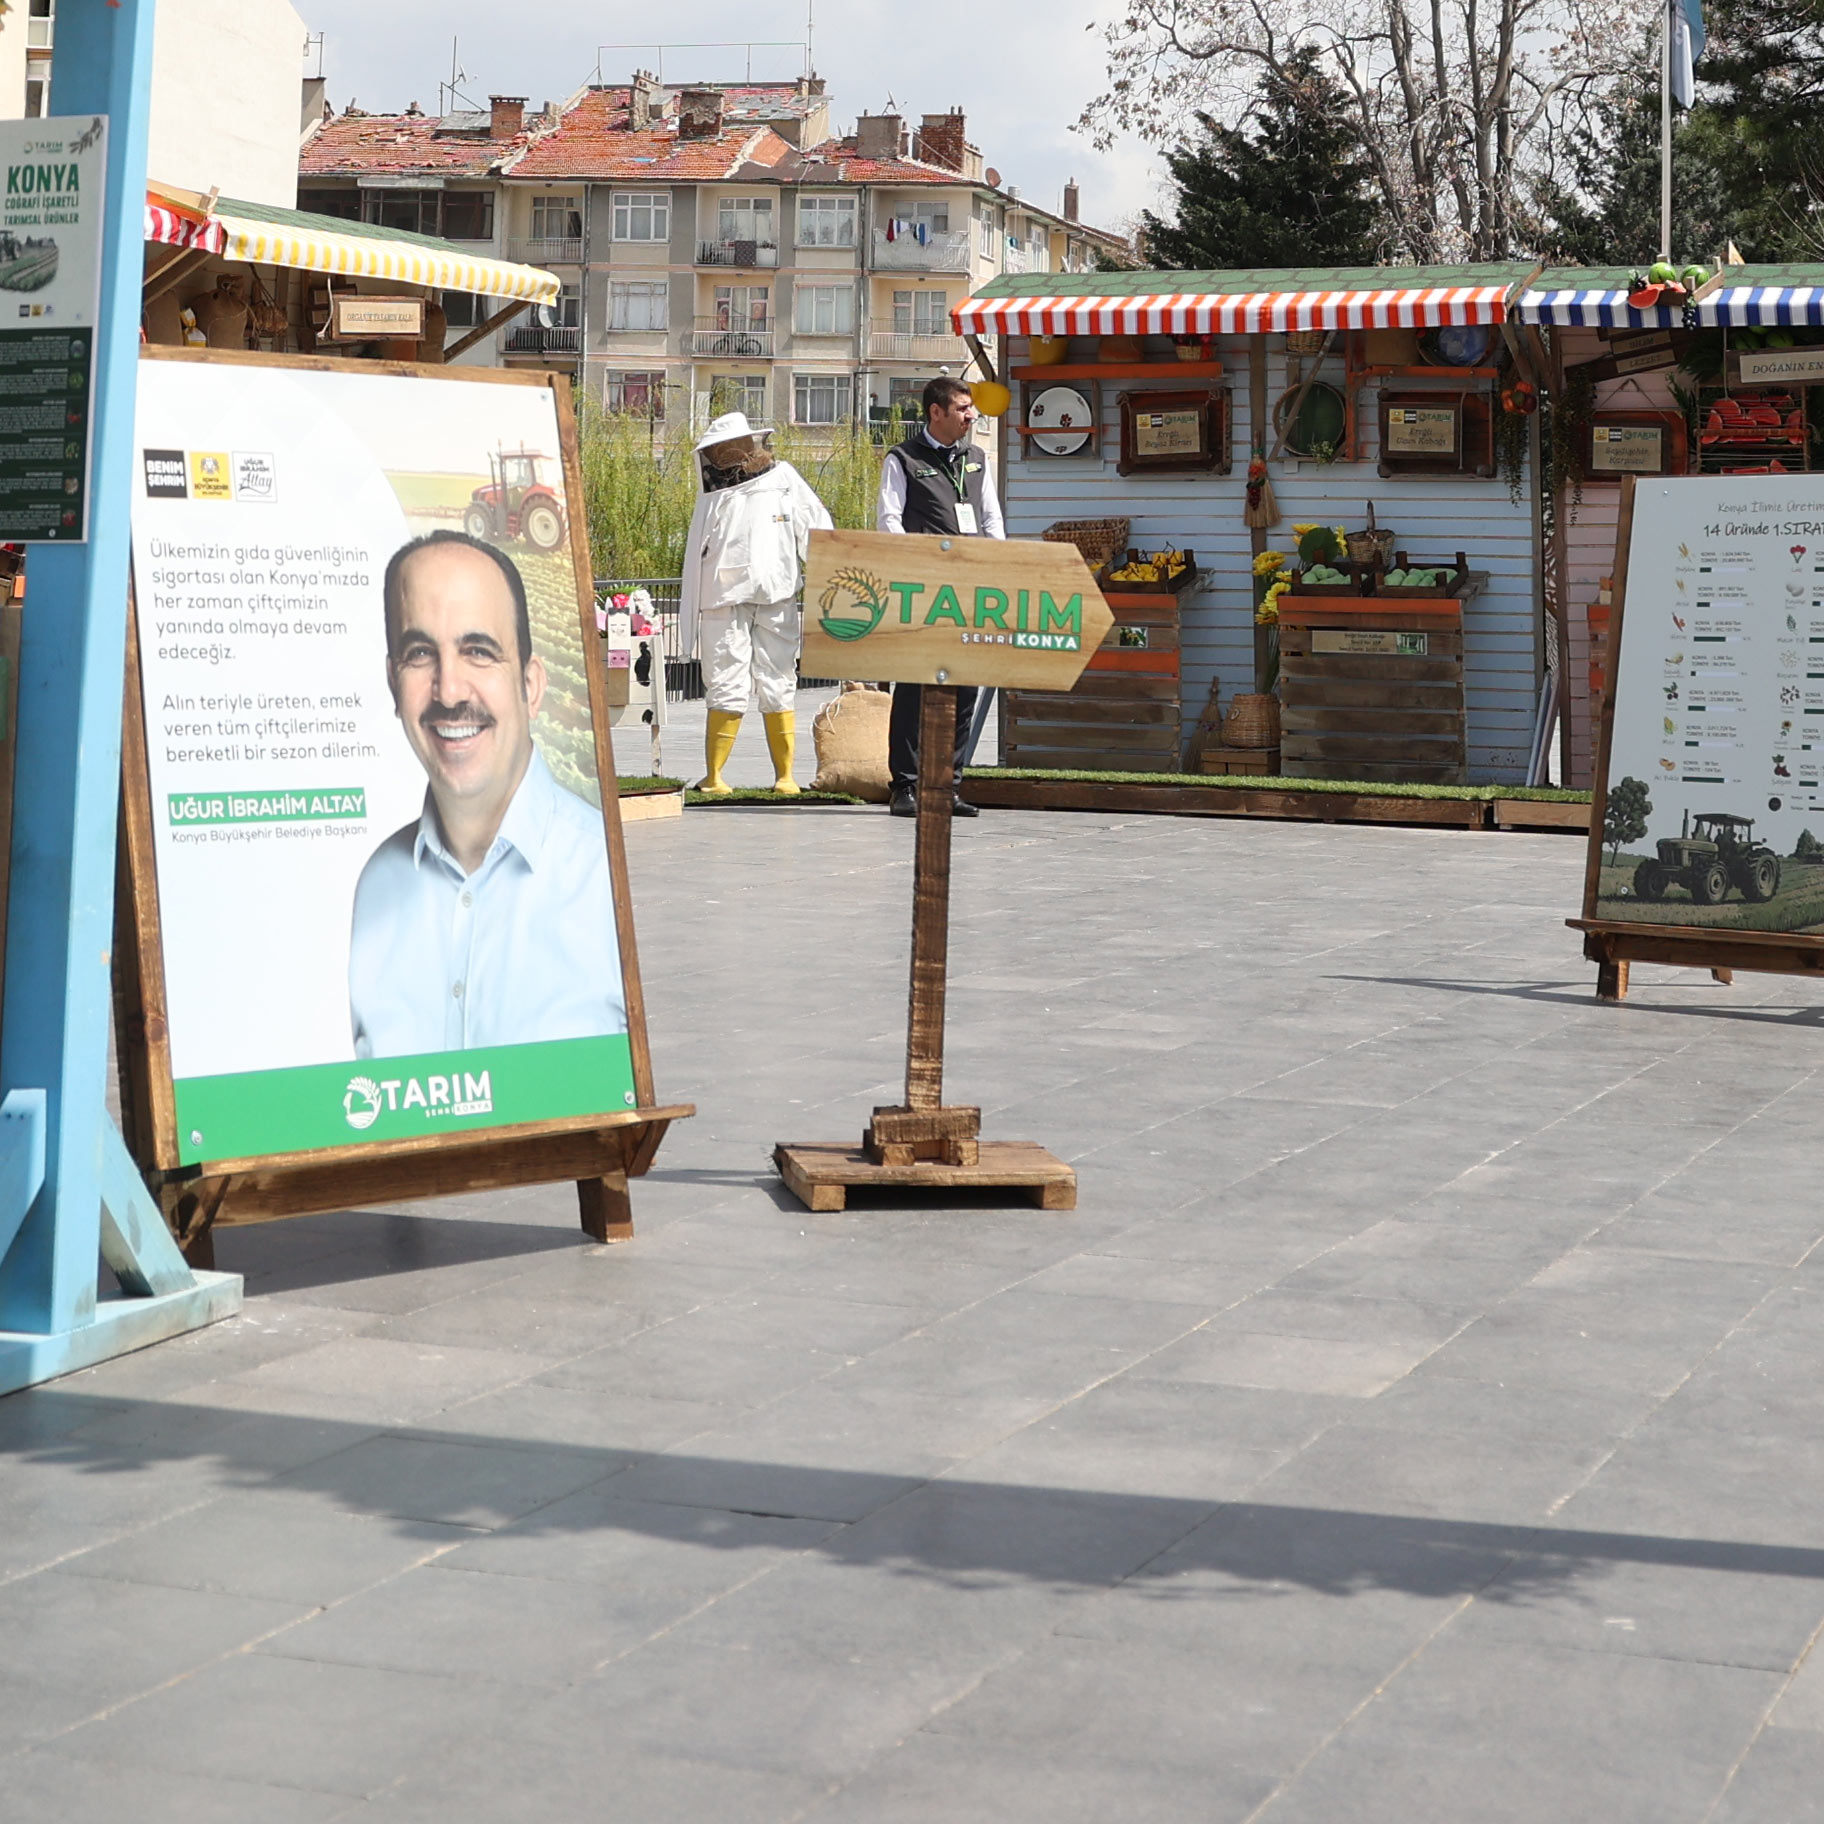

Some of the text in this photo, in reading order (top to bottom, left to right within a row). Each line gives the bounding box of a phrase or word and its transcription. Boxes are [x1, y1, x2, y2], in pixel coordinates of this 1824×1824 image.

[7, 163, 79, 194] KONYA
[5, 195, 78, 210] COĞRAFİ İŞARETLİ
[4, 211, 79, 225] TARIMSAL ÜRÜNLER
[1752, 361, 1804, 374] DOĞANIN
[1808, 360, 1824, 371] EN
[146, 460, 184, 474] BENİM
[1718, 502, 1747, 514] Konya
[1704, 524, 1721, 537] 14
[150, 538, 369, 567] Ülkemizin gıda güvenliğinin
[152, 567, 369, 589] sigortası olan Konya'mızda
[154, 593, 328, 614] her zaman çiftçimizin
[889, 582, 1082, 632] TARIM
[156, 619, 347, 638] yanında olmaya devam
[962, 631, 1078, 650] ŞEHRİ KONYA
[158, 644, 236, 665] edeceğiz.
[162, 693, 362, 714] Alın teriyle üreten, emek
[164, 717, 356, 739] veren tüm çiftçilerimize
[166, 741, 381, 762] bereketli bir sezon dilerim.
[170, 793, 364, 819] UĞUR İBRAHİM ALTAY
[172, 824, 367, 844] Konya Büyükşehir Belediye Başkanı
[380, 1070, 492, 1110] TARIM
